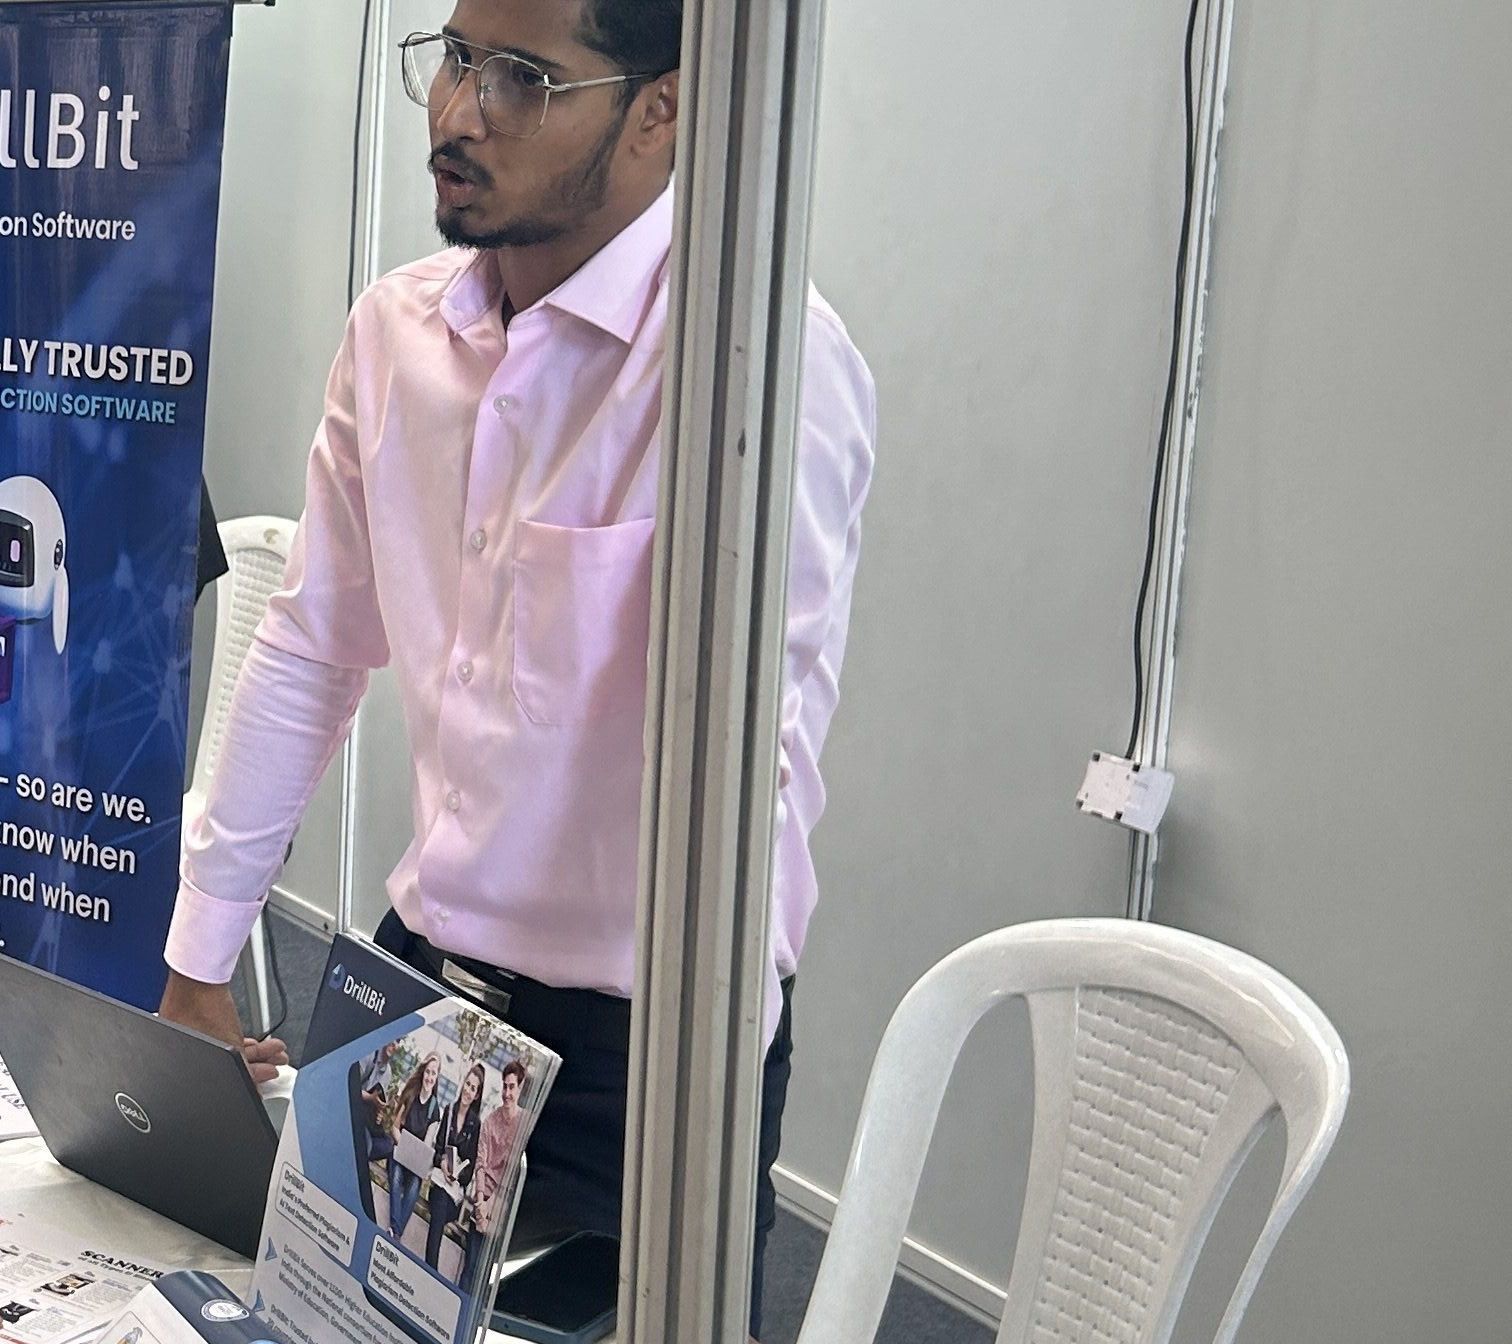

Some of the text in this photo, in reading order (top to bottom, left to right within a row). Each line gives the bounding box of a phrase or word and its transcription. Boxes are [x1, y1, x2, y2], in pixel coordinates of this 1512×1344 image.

[32, 211, 136, 241] Software
[44, 341, 194, 386] TRUSTED
[61, 394, 176, 424] SOFTWARE
[16, 773, 46, 801] so
[51, 782, 93, 812] are
[101, 792, 152, 824] we.
[60, 834, 136, 874] when
[41, 882, 110, 922] when
[344, 975, 386, 1016] DrillBit
[317, 1228, 339, 1252] Software
[375, 1239, 399, 1267] DrillBit
[80, 1250, 165, 1279] SCANNER
[369, 1270, 450, 1340] Plagiarism Detection Software
